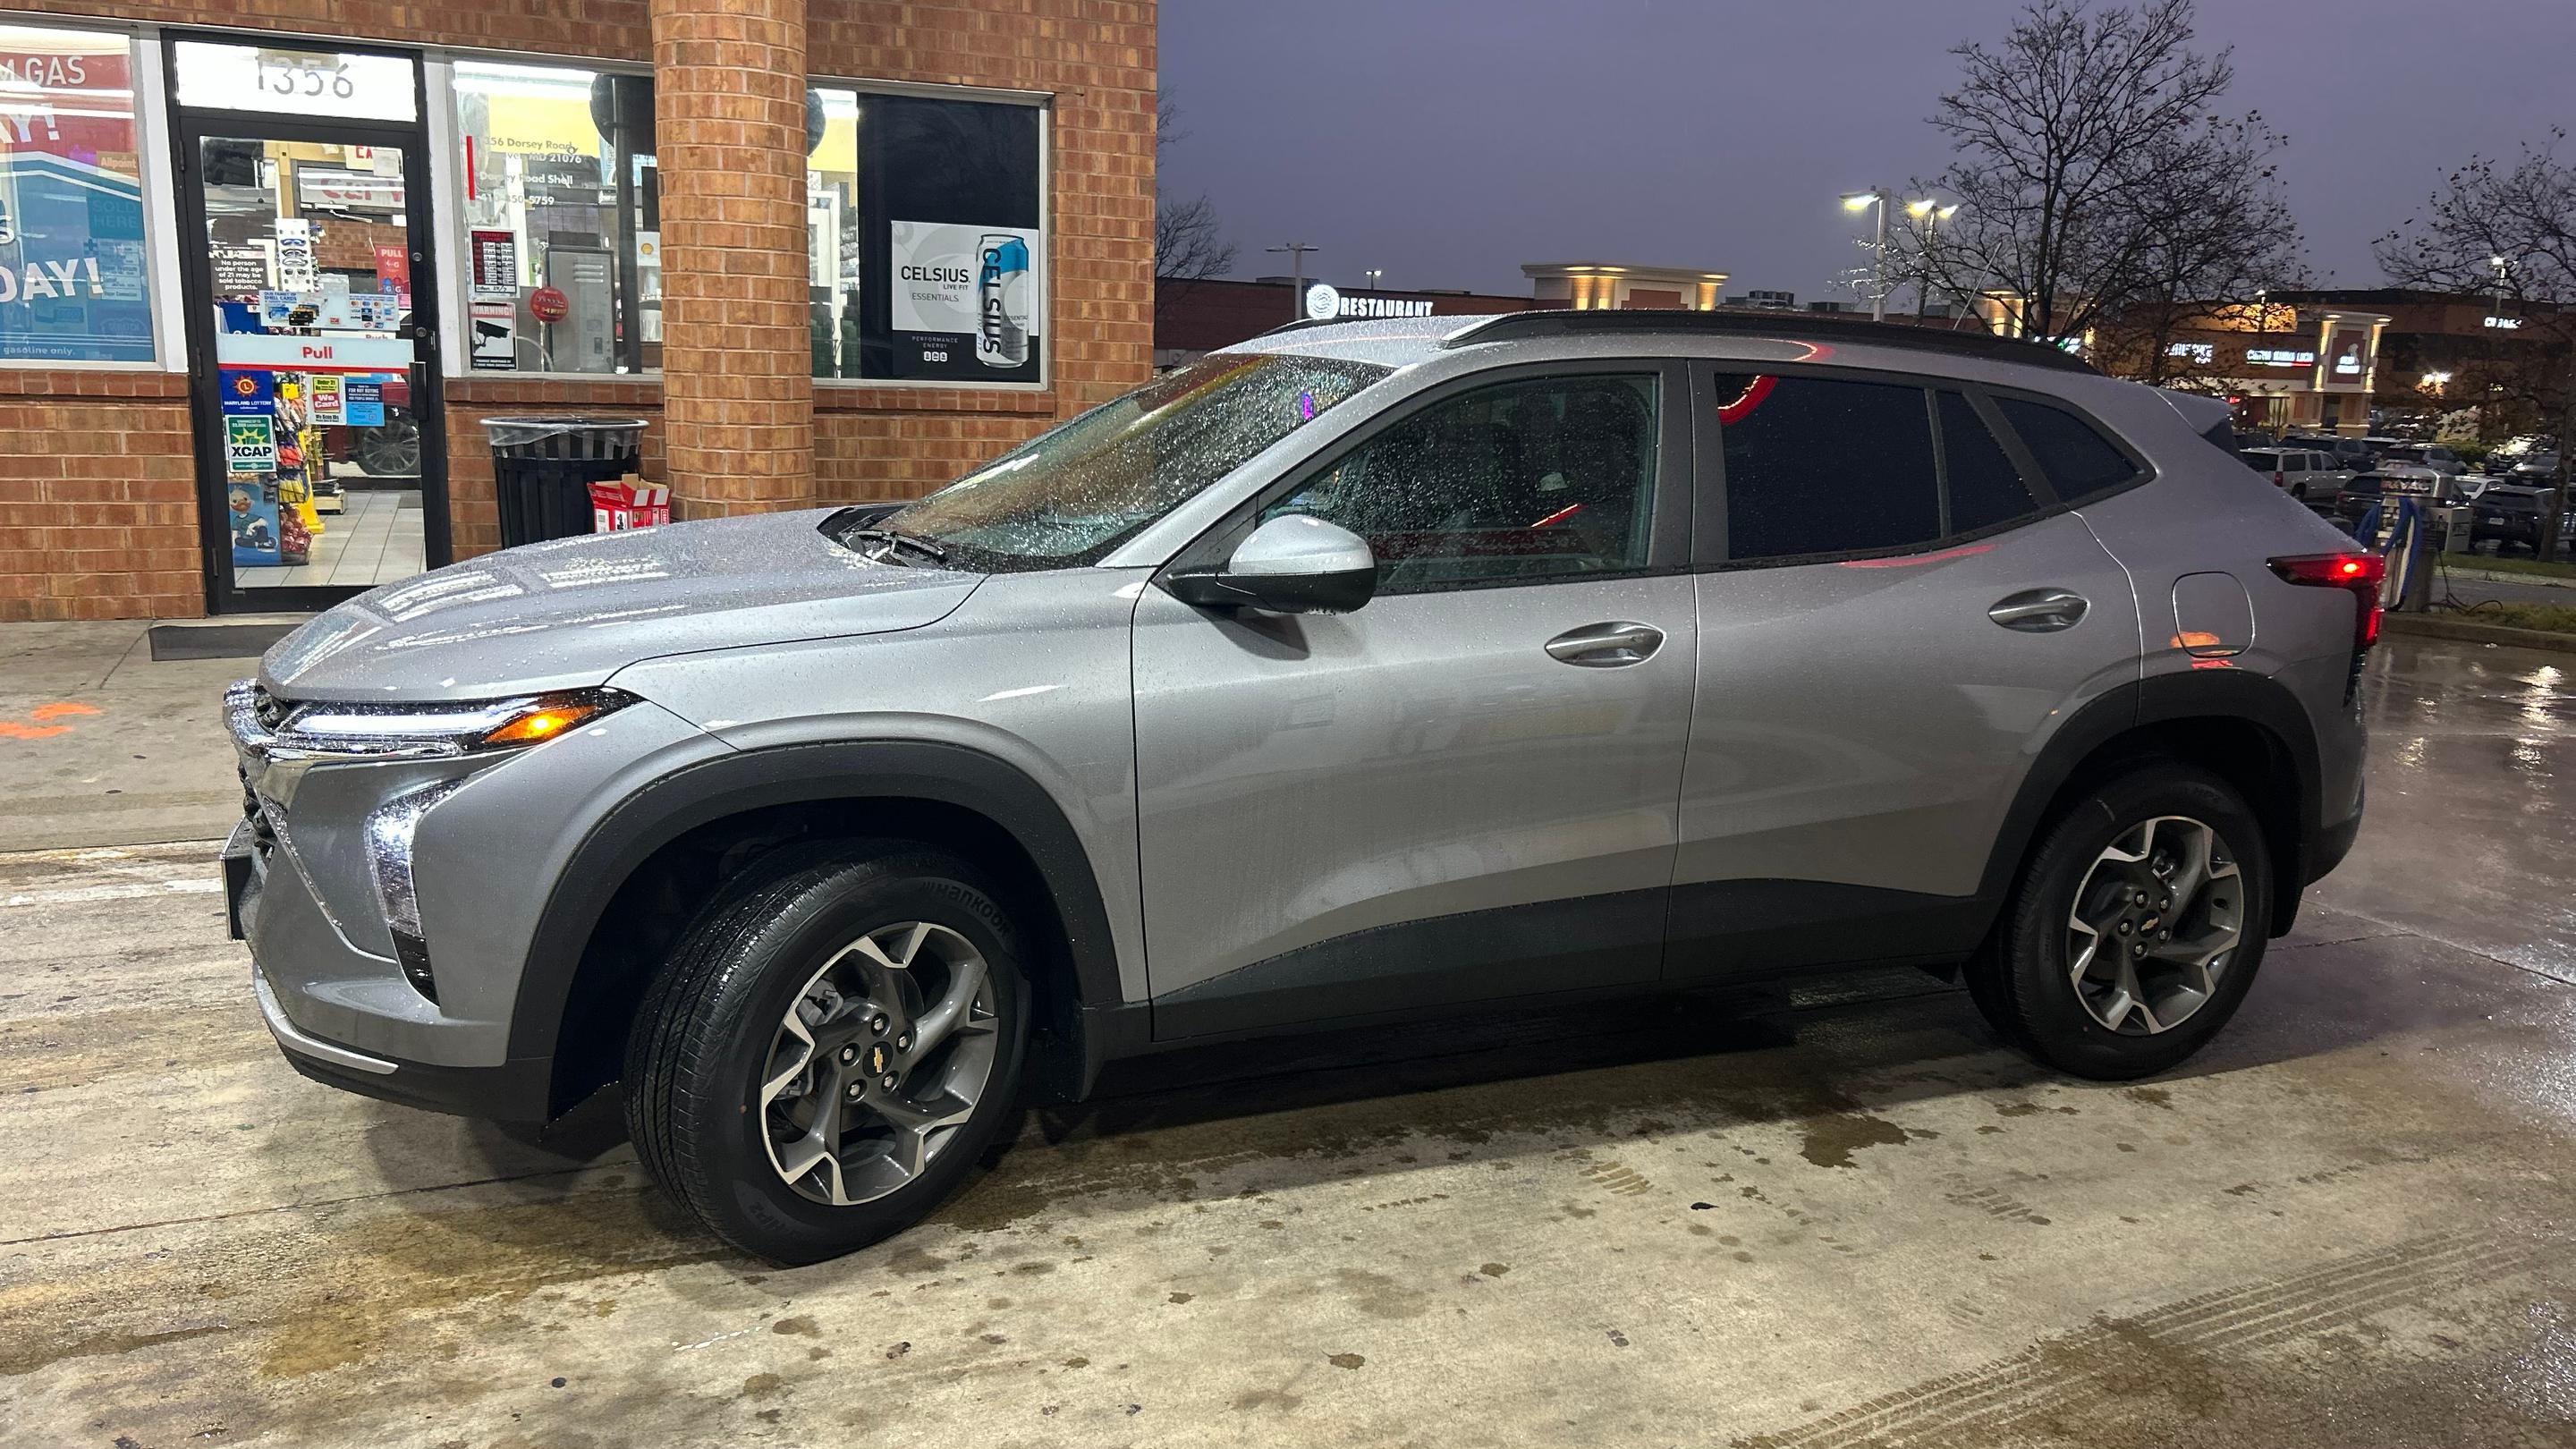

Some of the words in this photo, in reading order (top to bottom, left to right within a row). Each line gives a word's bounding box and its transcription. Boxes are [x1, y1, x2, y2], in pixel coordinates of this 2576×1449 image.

[25, 55, 86, 87] GAS
[255, 55, 353, 98] 1356
[507, 138, 543, 150] Dorsey
[546, 140, 573, 150] Road
[100, 156, 137, 169] Allpoint
[549, 154, 582, 164] 21076
[547, 174, 573, 185] Shell
[381, 249, 403, 258] PULL
[233, 259, 257, 267] person
[901, 266, 969, 283] CELSIUS
[911, 292, 960, 302] ESSENTIALS
[982, 248, 1002, 354] CELSIUS
[1339, 297, 1434, 318] RESTAURANT
[911, 335, 959, 343] PERFORMANCE
[3, 347, 48, 356] gasoline
[50, 347, 76, 356] only.
[302, 346, 333, 360] Pull
[314, 399, 339, 408] Card
[318, 394, 335, 402] We
[231, 446, 273, 457] XCAP
